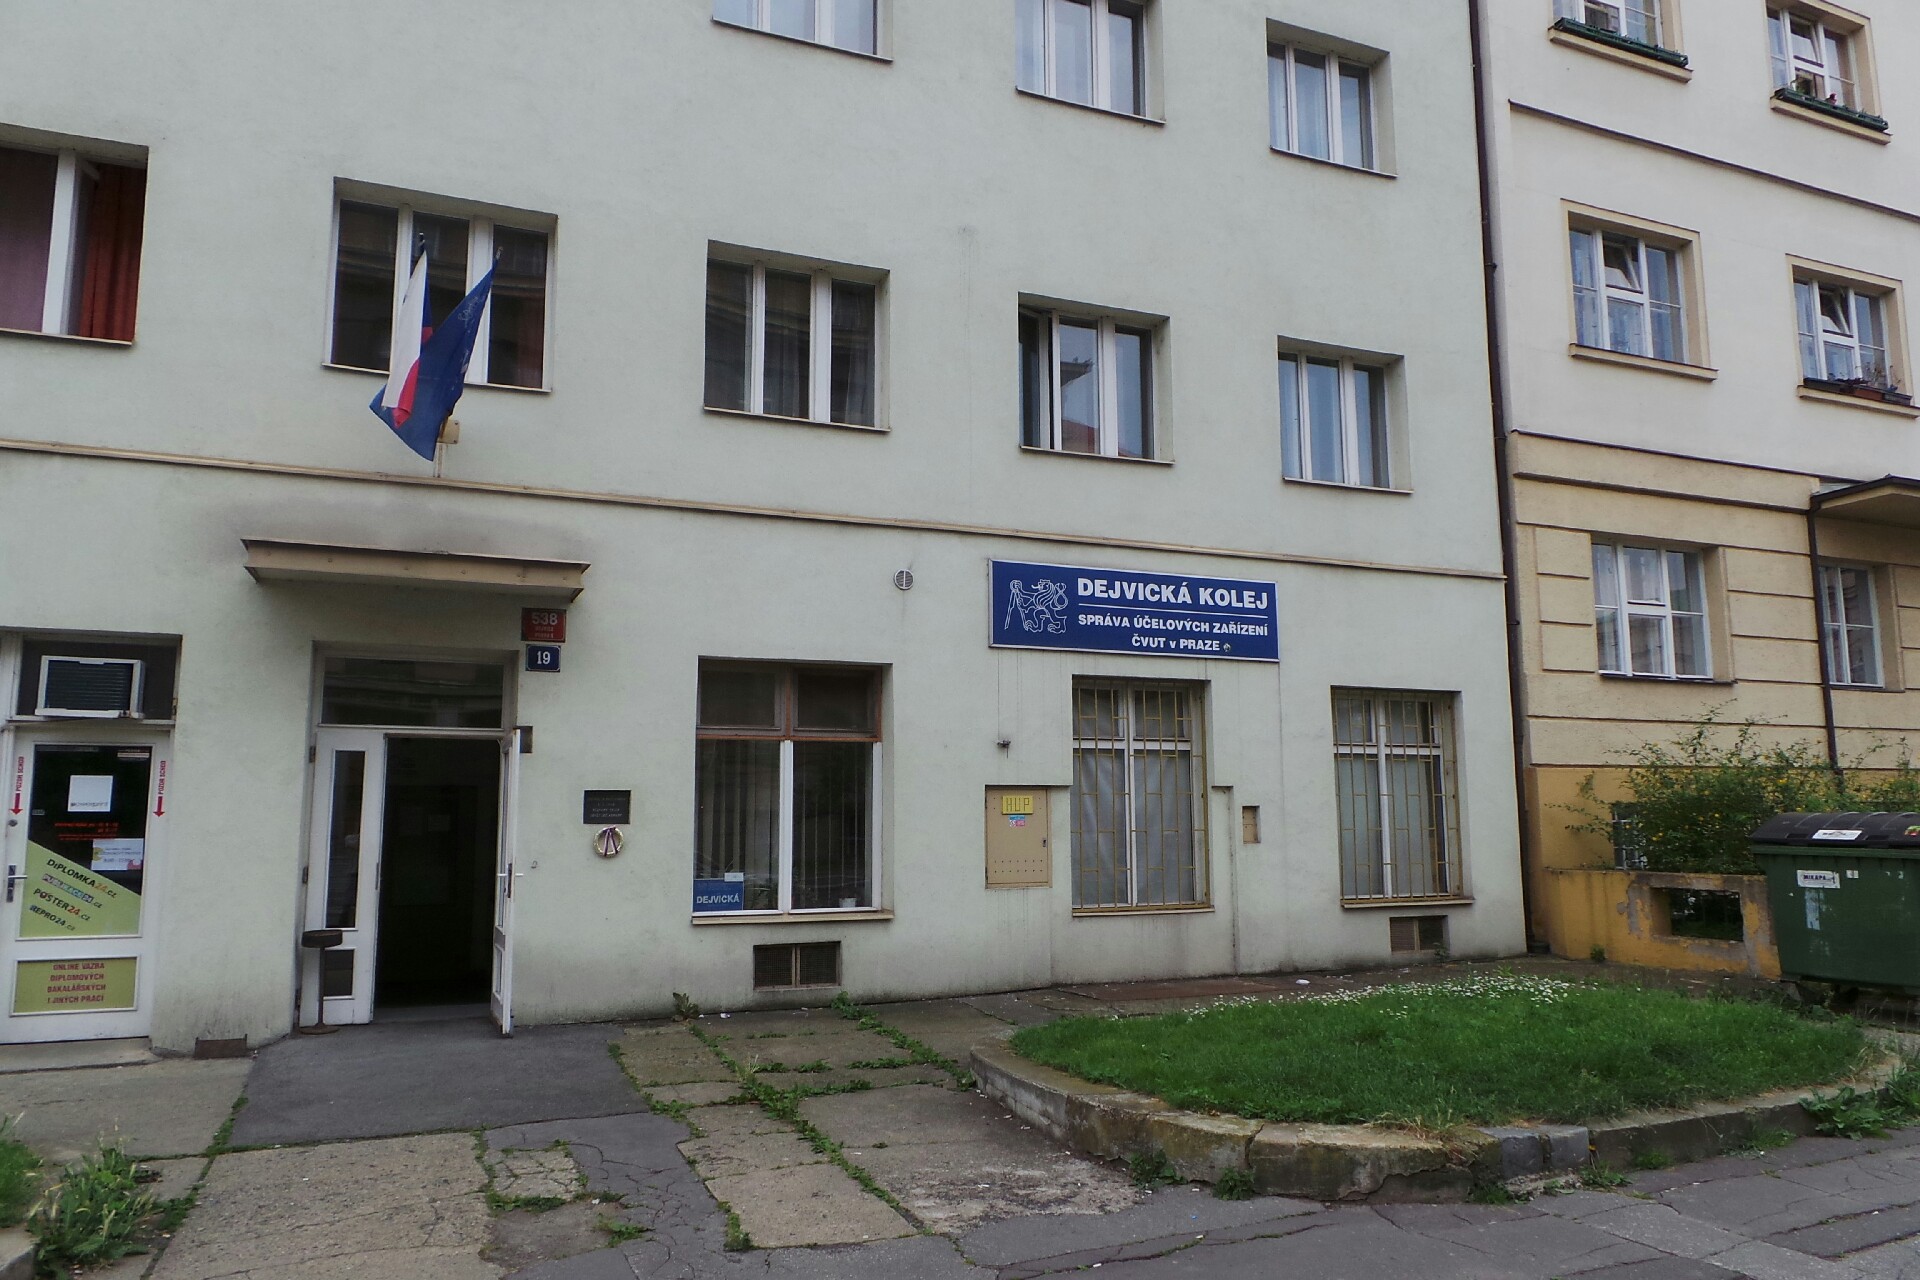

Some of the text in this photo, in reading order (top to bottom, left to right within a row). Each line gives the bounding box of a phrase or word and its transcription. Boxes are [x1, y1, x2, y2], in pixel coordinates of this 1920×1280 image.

[1077, 577, 1268, 610] DEJVICKÁ KOLEJ
[531, 611, 558, 626] 538
[1078, 613, 1268, 636] SPRÁVA ÚČELOVÝCH ZAŘÍZENÍ
[1132, 633, 1166, 648] ČVUT
[1179, 638, 1221, 651] PRAZE
[536, 650, 551, 665] 19
[1006, 797, 1030, 812] HUP
[696, 892, 740, 904] DEJVICKÁ
[53, 963, 79, 971] ONLINE
